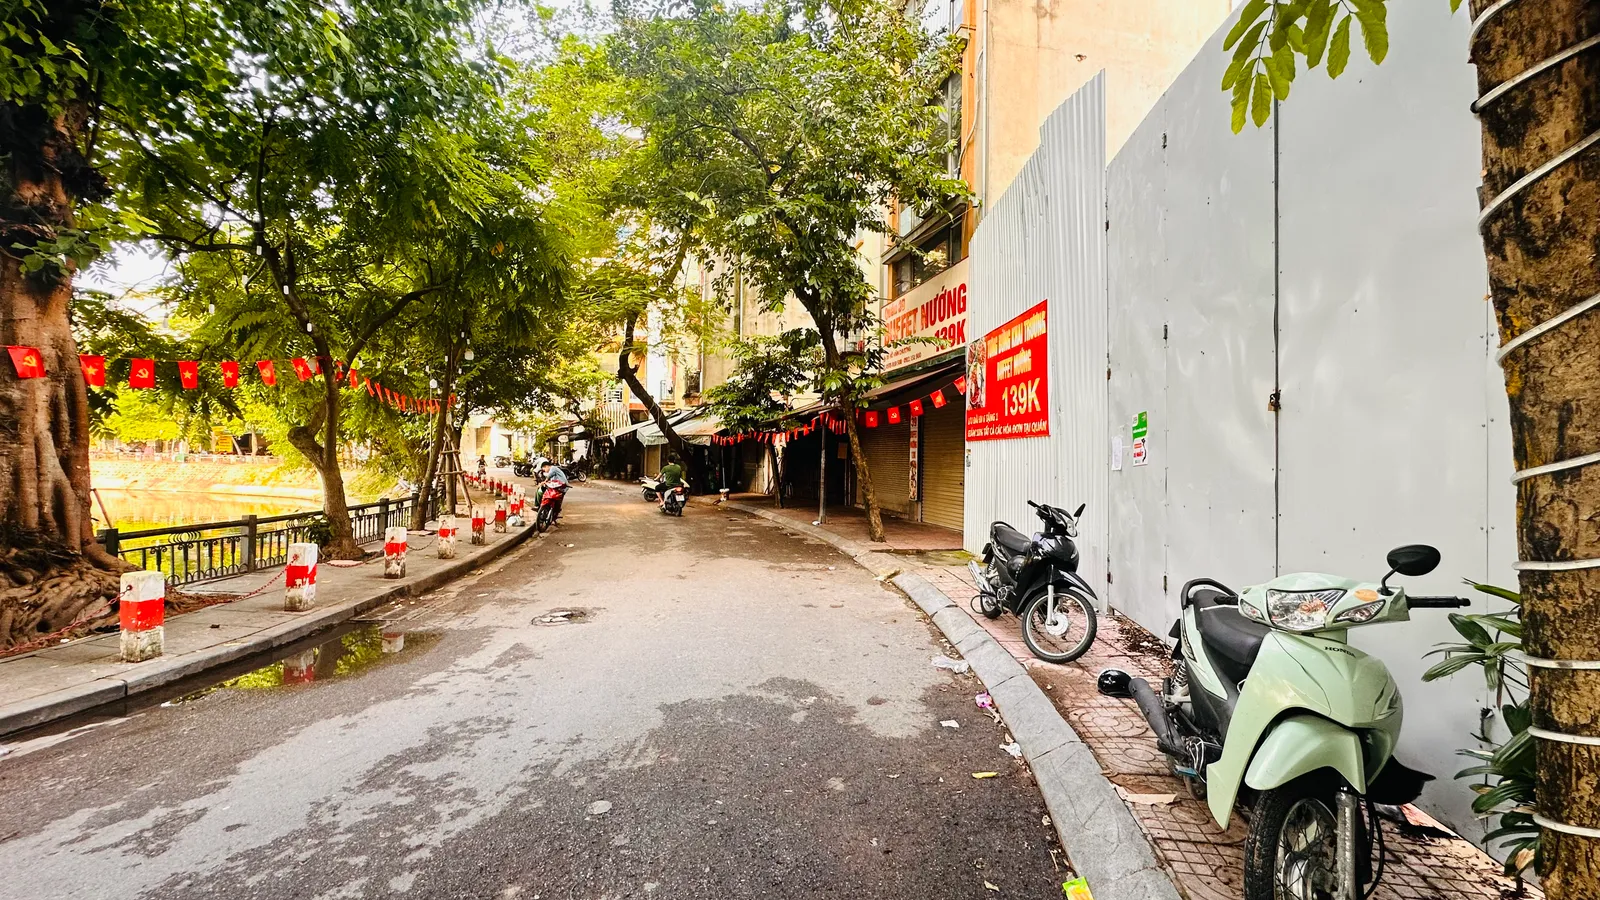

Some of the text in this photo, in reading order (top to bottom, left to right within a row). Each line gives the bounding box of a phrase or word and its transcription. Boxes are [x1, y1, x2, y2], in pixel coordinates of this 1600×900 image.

[920, 283, 967, 331] NƯỚNG
[934, 318, 966, 353] 139K
[1002, 377, 1041, 417] 139K
[1032, 418, 1047, 434] QUÁN
[1325, 646, 1356, 658] HONDA
